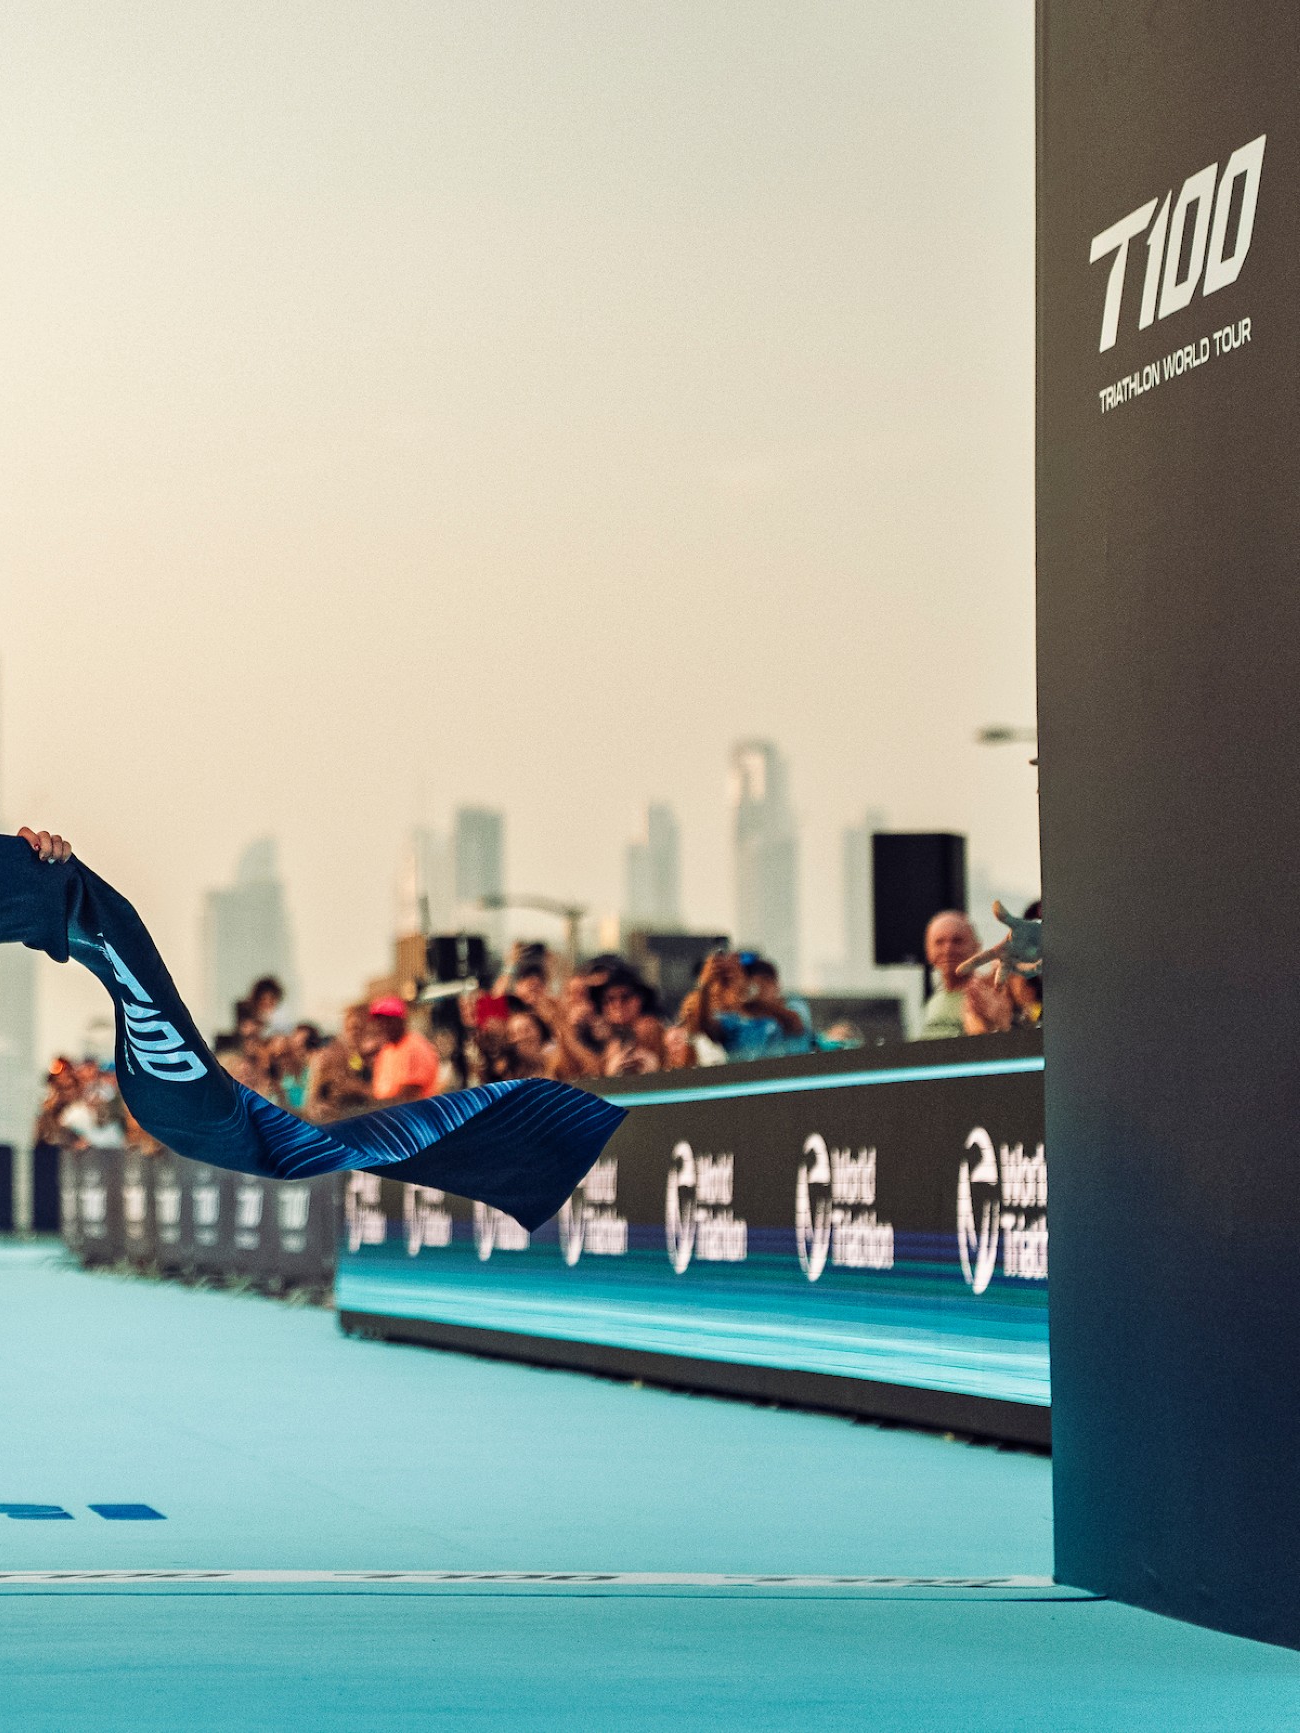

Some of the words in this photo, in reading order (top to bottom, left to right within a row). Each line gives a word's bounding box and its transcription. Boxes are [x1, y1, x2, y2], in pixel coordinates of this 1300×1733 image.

[1090, 134, 1266, 353] T100
[1099, 361, 1160, 413] TRIATHLON
[1163, 337, 1210, 382] WORLD
[1213, 316, 1251, 356] TOUR
